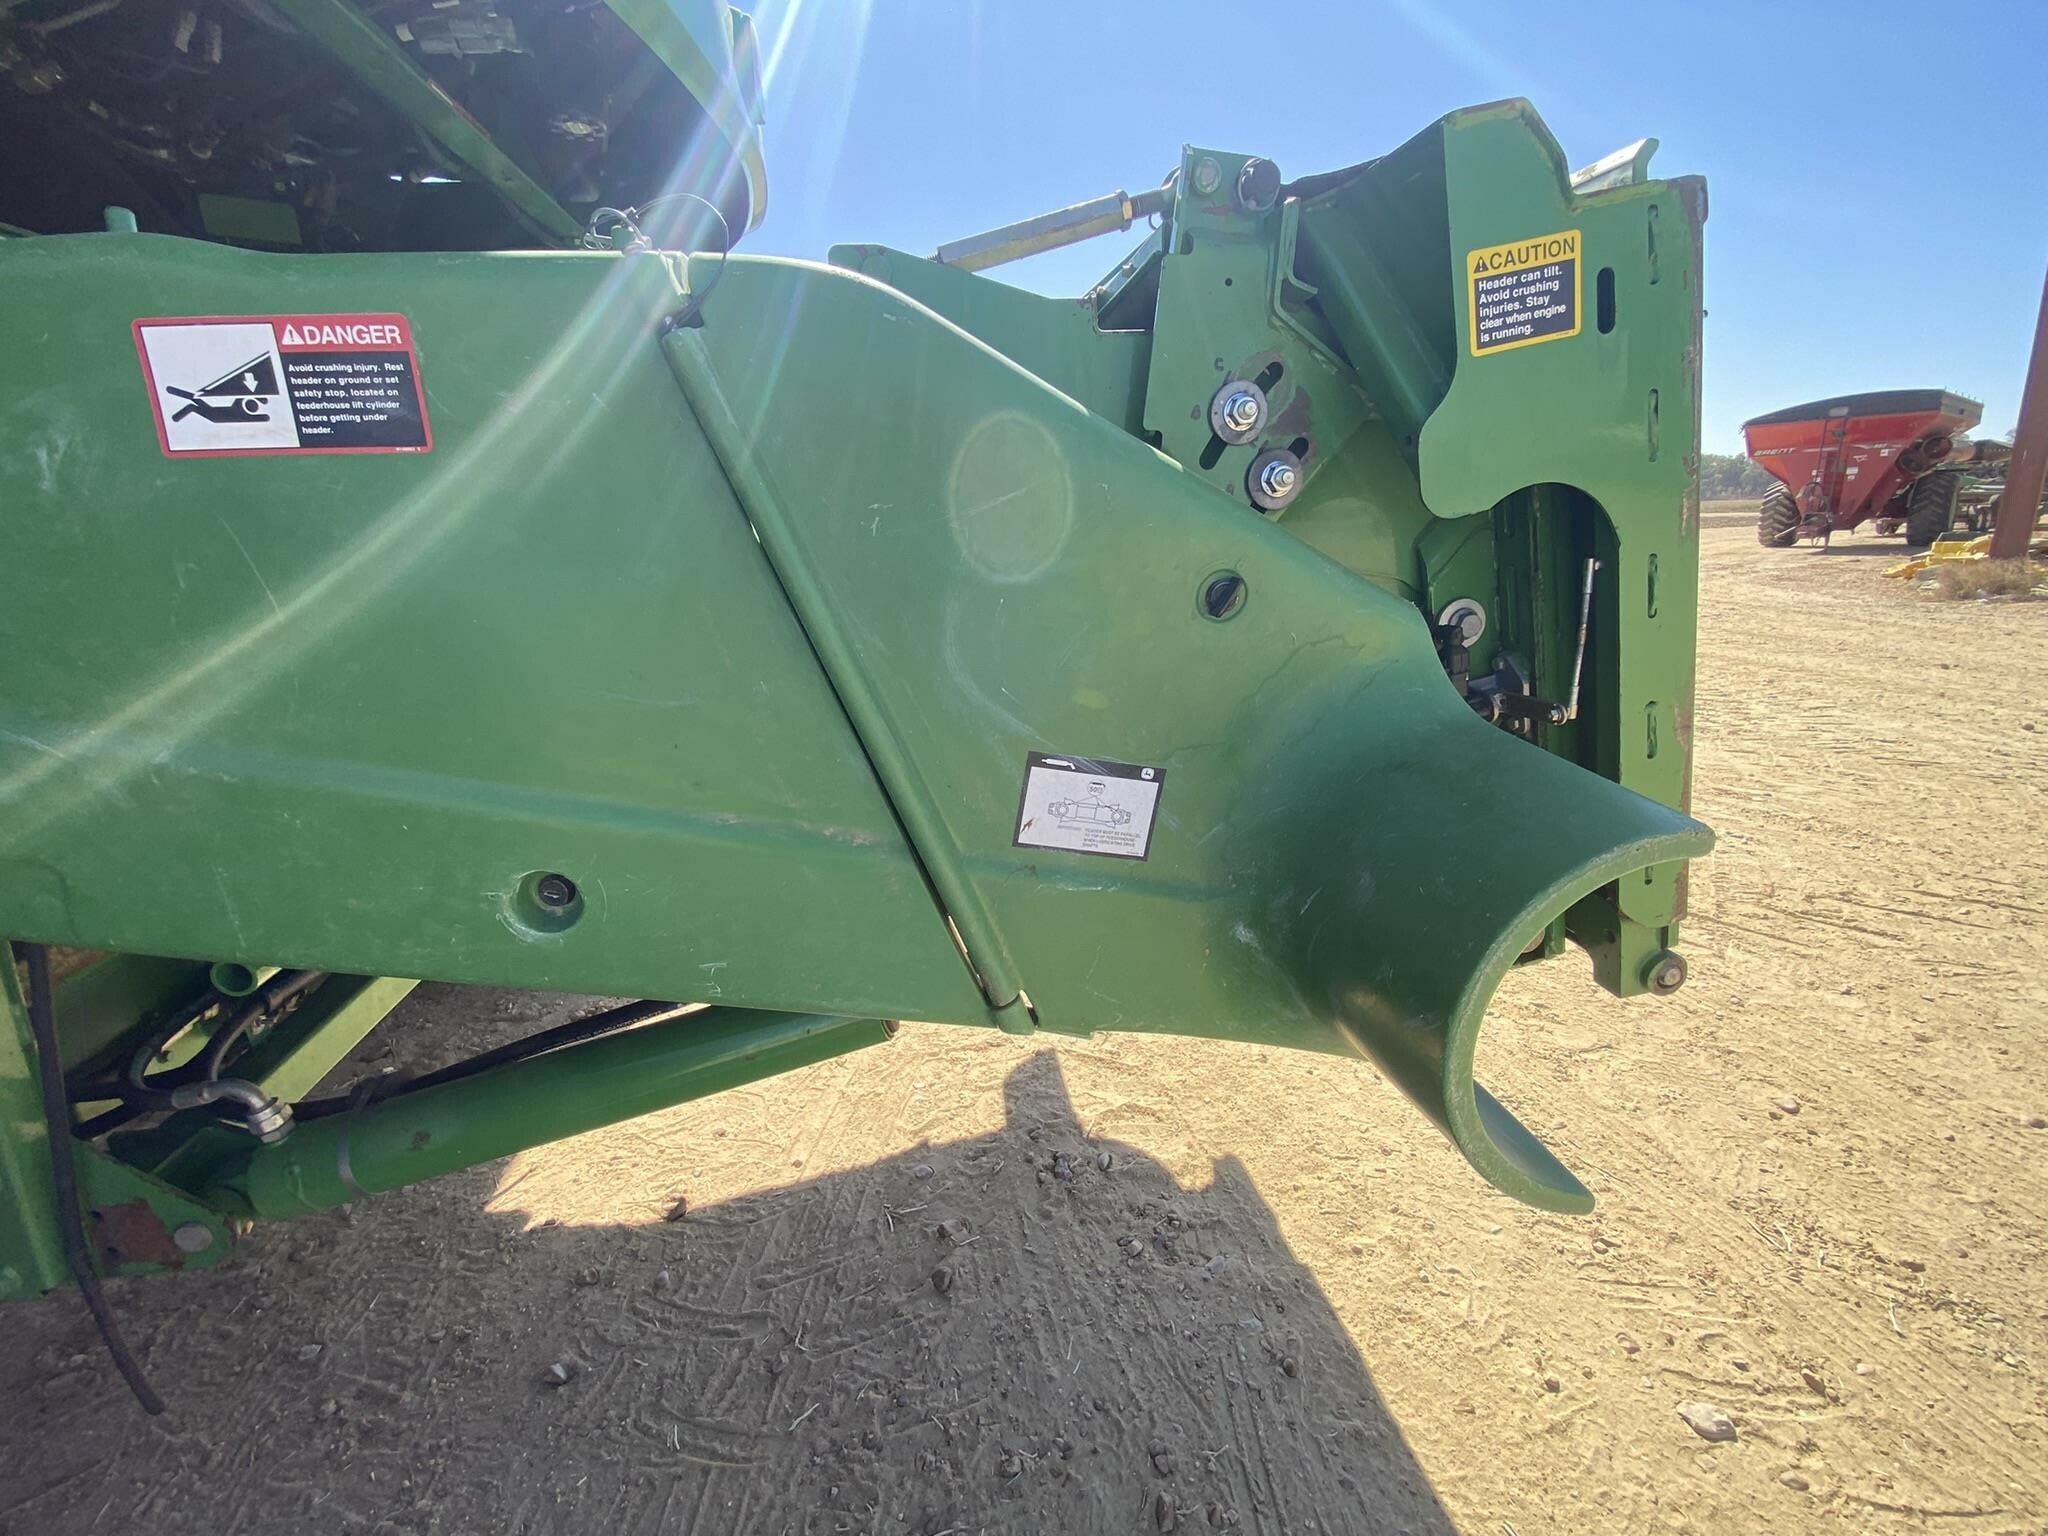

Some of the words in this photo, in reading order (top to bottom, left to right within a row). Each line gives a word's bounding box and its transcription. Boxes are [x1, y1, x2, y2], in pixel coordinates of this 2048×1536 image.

[1489, 236, 1575, 270] CAUTION
[1478, 274, 1518, 292] Header
[1520, 270, 1541, 283] can
[1543, 265, 1563, 277] tilt.
[1479, 289, 1510, 305] Avoid
[1512, 279, 1560, 298] crushing
[1479, 301, 1523, 319] injuries.
[1525, 295, 1551, 308] Stay
[1480, 316, 1504, 331] clear
[1505, 311, 1532, 325] when
[1533, 303, 1567, 319] engine
[302, 324, 402, 346] DANGER
[1480, 332, 1490, 343] is
[1492, 323, 1534, 341] running.
[288, 363, 314, 372] Avoid
[314, 363, 353, 374] crushing
[353, 363, 382, 374] injury.
[384, 362, 405, 372] Rest
[290, 376, 323, 385] header
[324, 377, 337, 385] on
[338, 375, 371, 387] ground
[372, 377, 383, 385] or
[384, 375, 400, 385] set
[294, 389, 323, 399] safety
[324, 388, 350, 400] stop,
[350, 388, 385, 398] located
[386, 389, 399, 397] on
[296, 400, 351, 411] feederhouse
[351, 400, 364, 410] lift
[364, 400, 401, 411] cylinder
[299, 413, 329, 423] before
[330, 413, 362, 424] getting
[362, 413, 388, 422] under
[301, 425, 335, 435] header.
